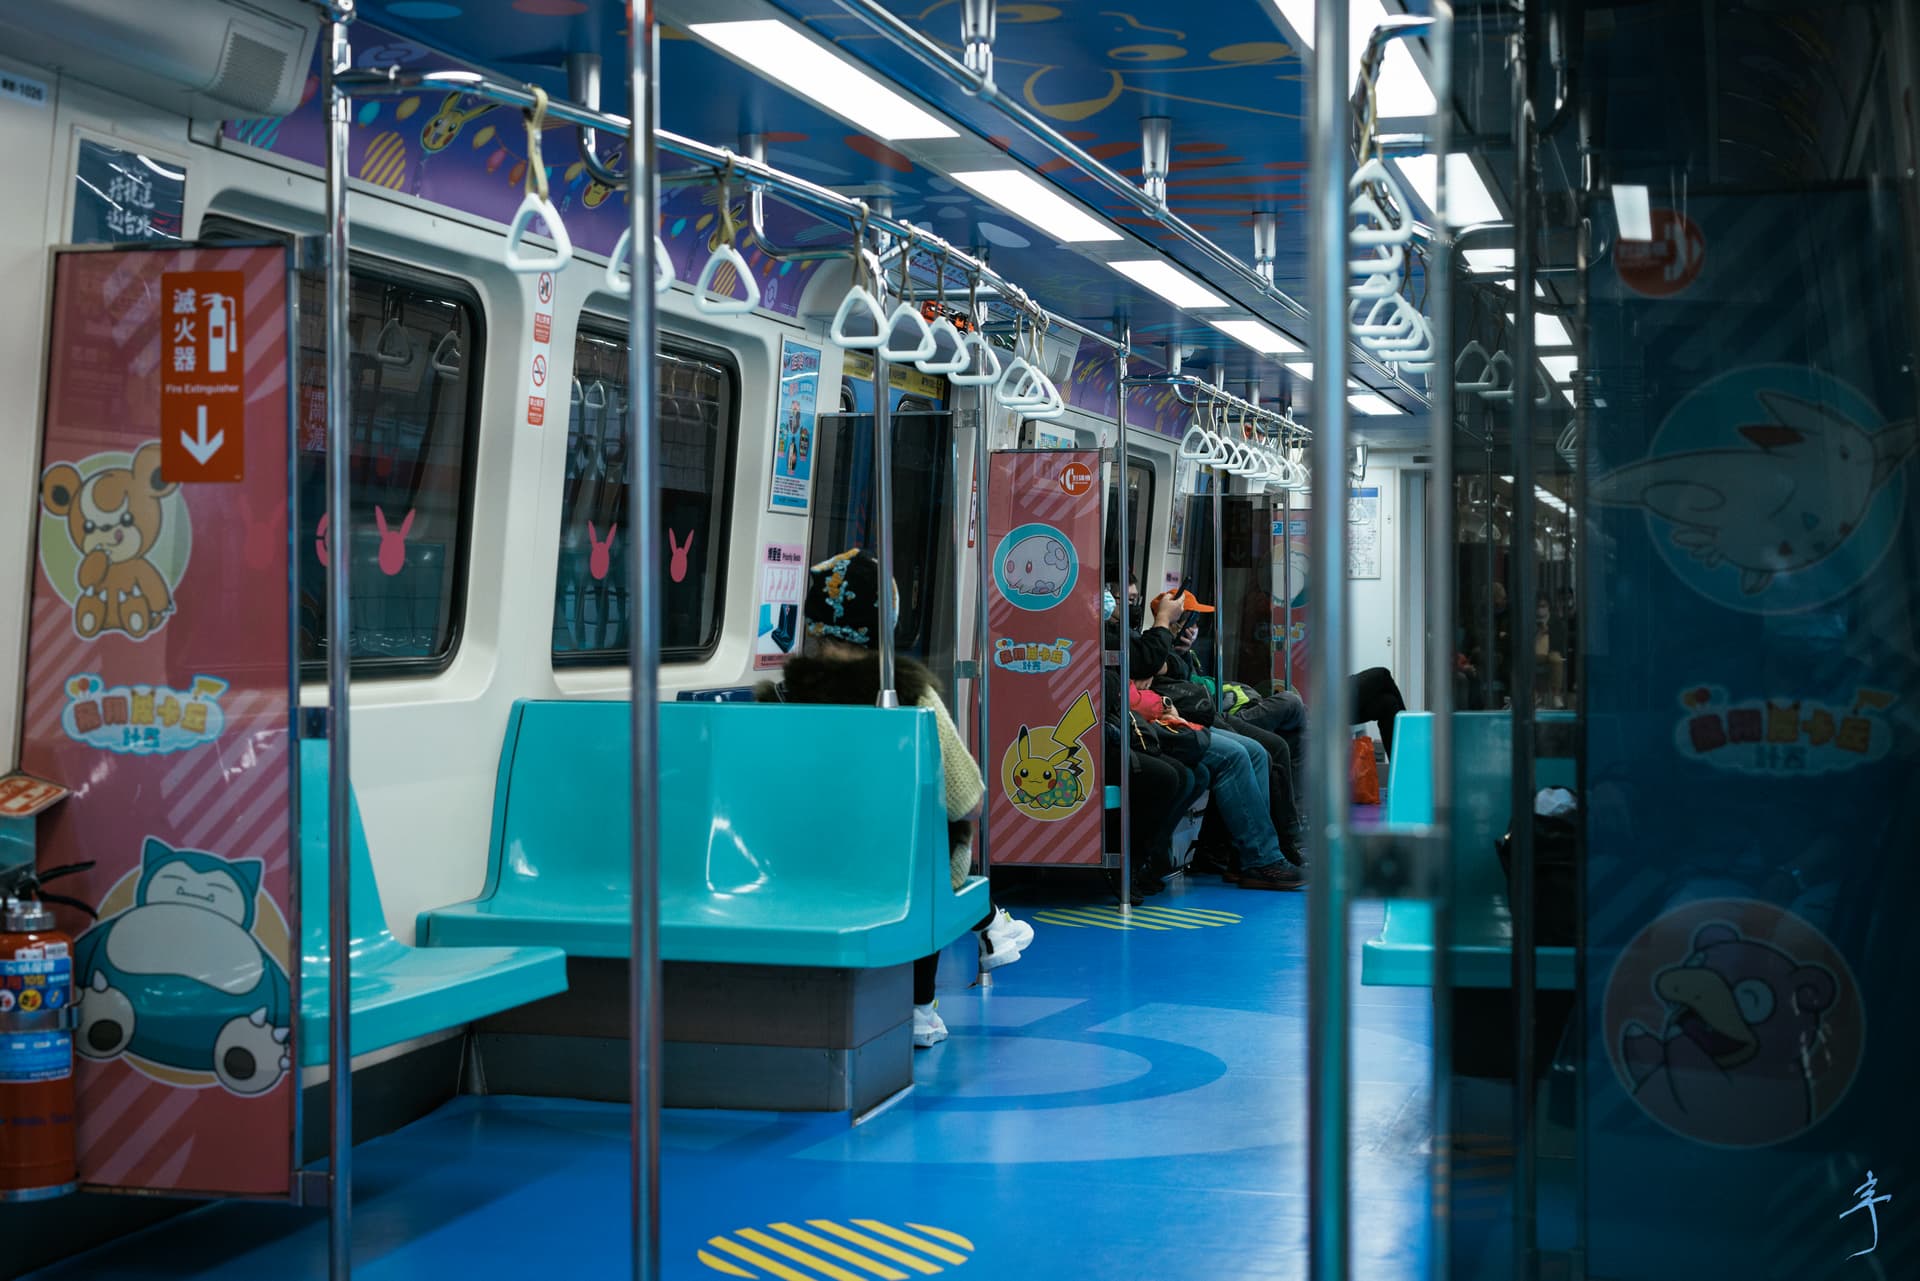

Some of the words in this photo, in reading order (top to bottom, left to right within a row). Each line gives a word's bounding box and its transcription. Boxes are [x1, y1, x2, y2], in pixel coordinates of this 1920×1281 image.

[173, 288, 197, 373] 滅火器
[165, 383, 182, 393] Fire
[184, 383, 240, 395] Extinguisher
